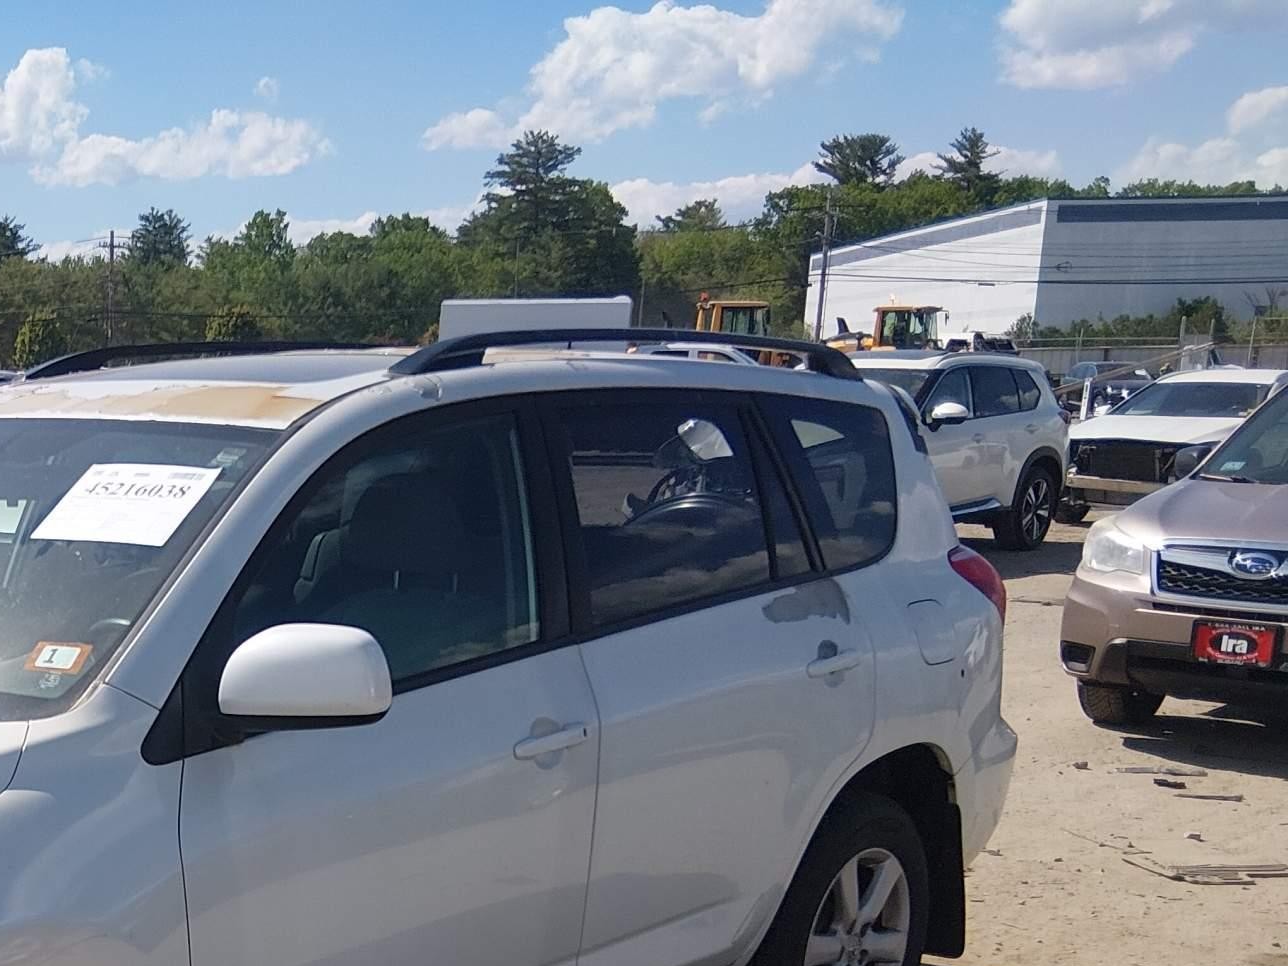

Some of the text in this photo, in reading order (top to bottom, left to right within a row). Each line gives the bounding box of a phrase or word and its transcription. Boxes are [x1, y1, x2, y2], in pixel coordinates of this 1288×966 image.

[85, 482, 191, 499] 45216038
[1220, 634, 1248, 654] Ira
[42, 648, 59, 664] 1
